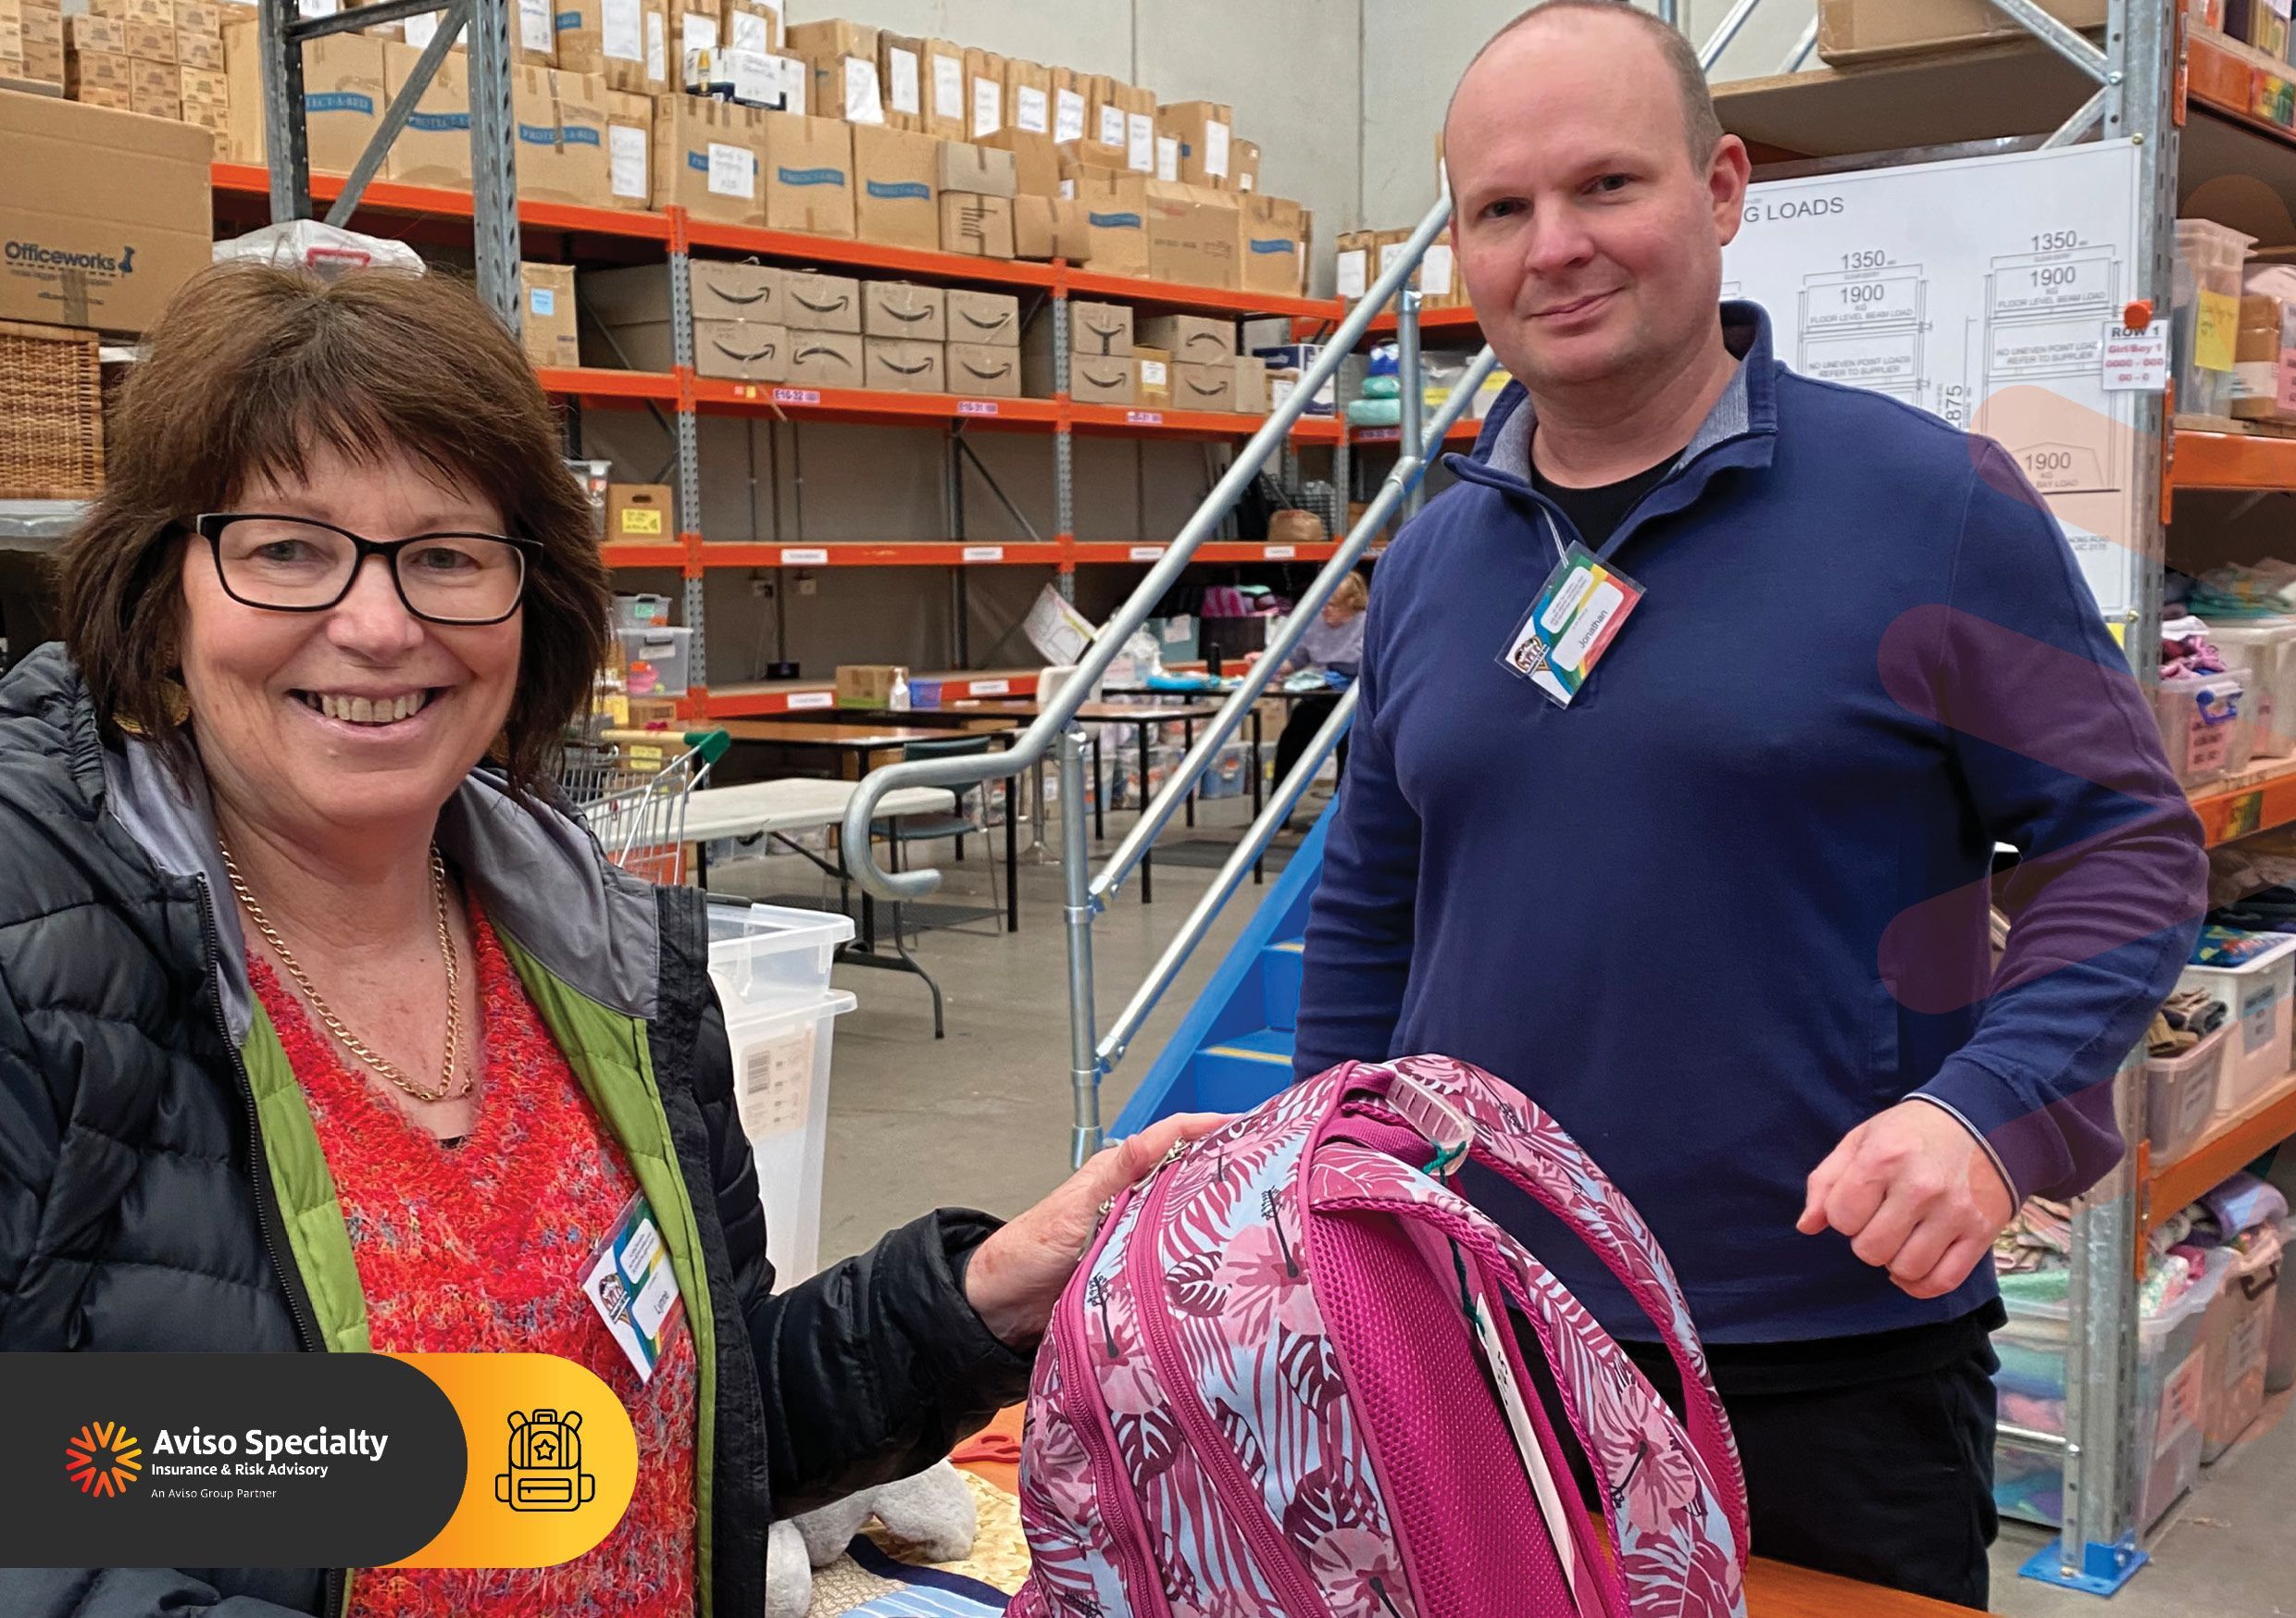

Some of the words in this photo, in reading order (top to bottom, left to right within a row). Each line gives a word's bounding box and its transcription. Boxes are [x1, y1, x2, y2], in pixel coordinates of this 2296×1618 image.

[1767, 196, 1844, 220] LOADS
[2031, 230, 2077, 251] 1350
[5, 241, 117, 270] Officeworks
[1841, 249, 1885, 269] 1350
[2029, 266, 2076, 287] 1900
[1841, 284, 1884, 304] 1900
[1810, 313, 1838, 324] FLOOR
[1839, 312, 1863, 322] LEVEL
[1890, 307, 1914, 317] LOAD
[2152, 326, 2159, 336] 1
[1945, 385, 1963, 429] 875
[2025, 452, 2071, 471] 1900
[1578, 609, 1608, 650] Jonathan
